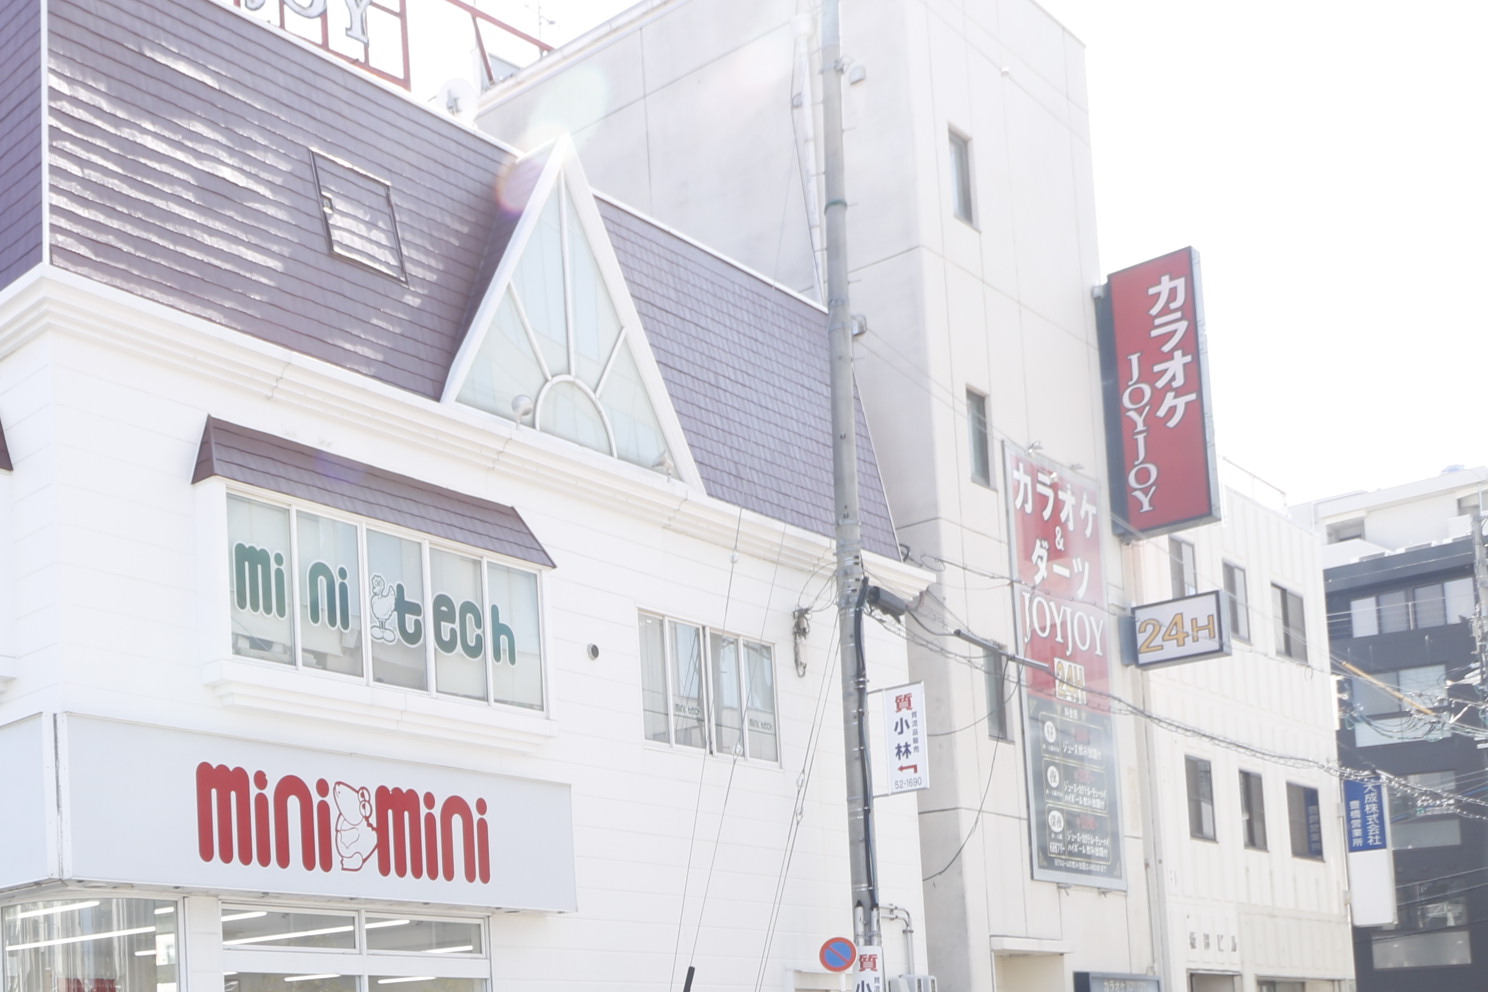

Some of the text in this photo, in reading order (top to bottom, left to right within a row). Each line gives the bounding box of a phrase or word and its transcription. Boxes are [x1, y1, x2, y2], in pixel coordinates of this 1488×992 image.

[1147, 274, 1197, 429] カラオケ
[1122, 352, 1158, 513] JOYJOY
[1013, 462, 1096, 538] カラオケ
[1031, 538, 1089, 600] ダーツ
[1055, 526, 1064, 551] &
[233, 542, 516, 666] mini tech
[1022, 591, 1103, 657] JOYJOY
[1138, 612, 1215, 654] 24H
[895, 693, 913, 713] 質
[894, 717, 912, 761] 小林
[196, 762, 491, 884] mini mini
[858, 954, 878, 972] 質
